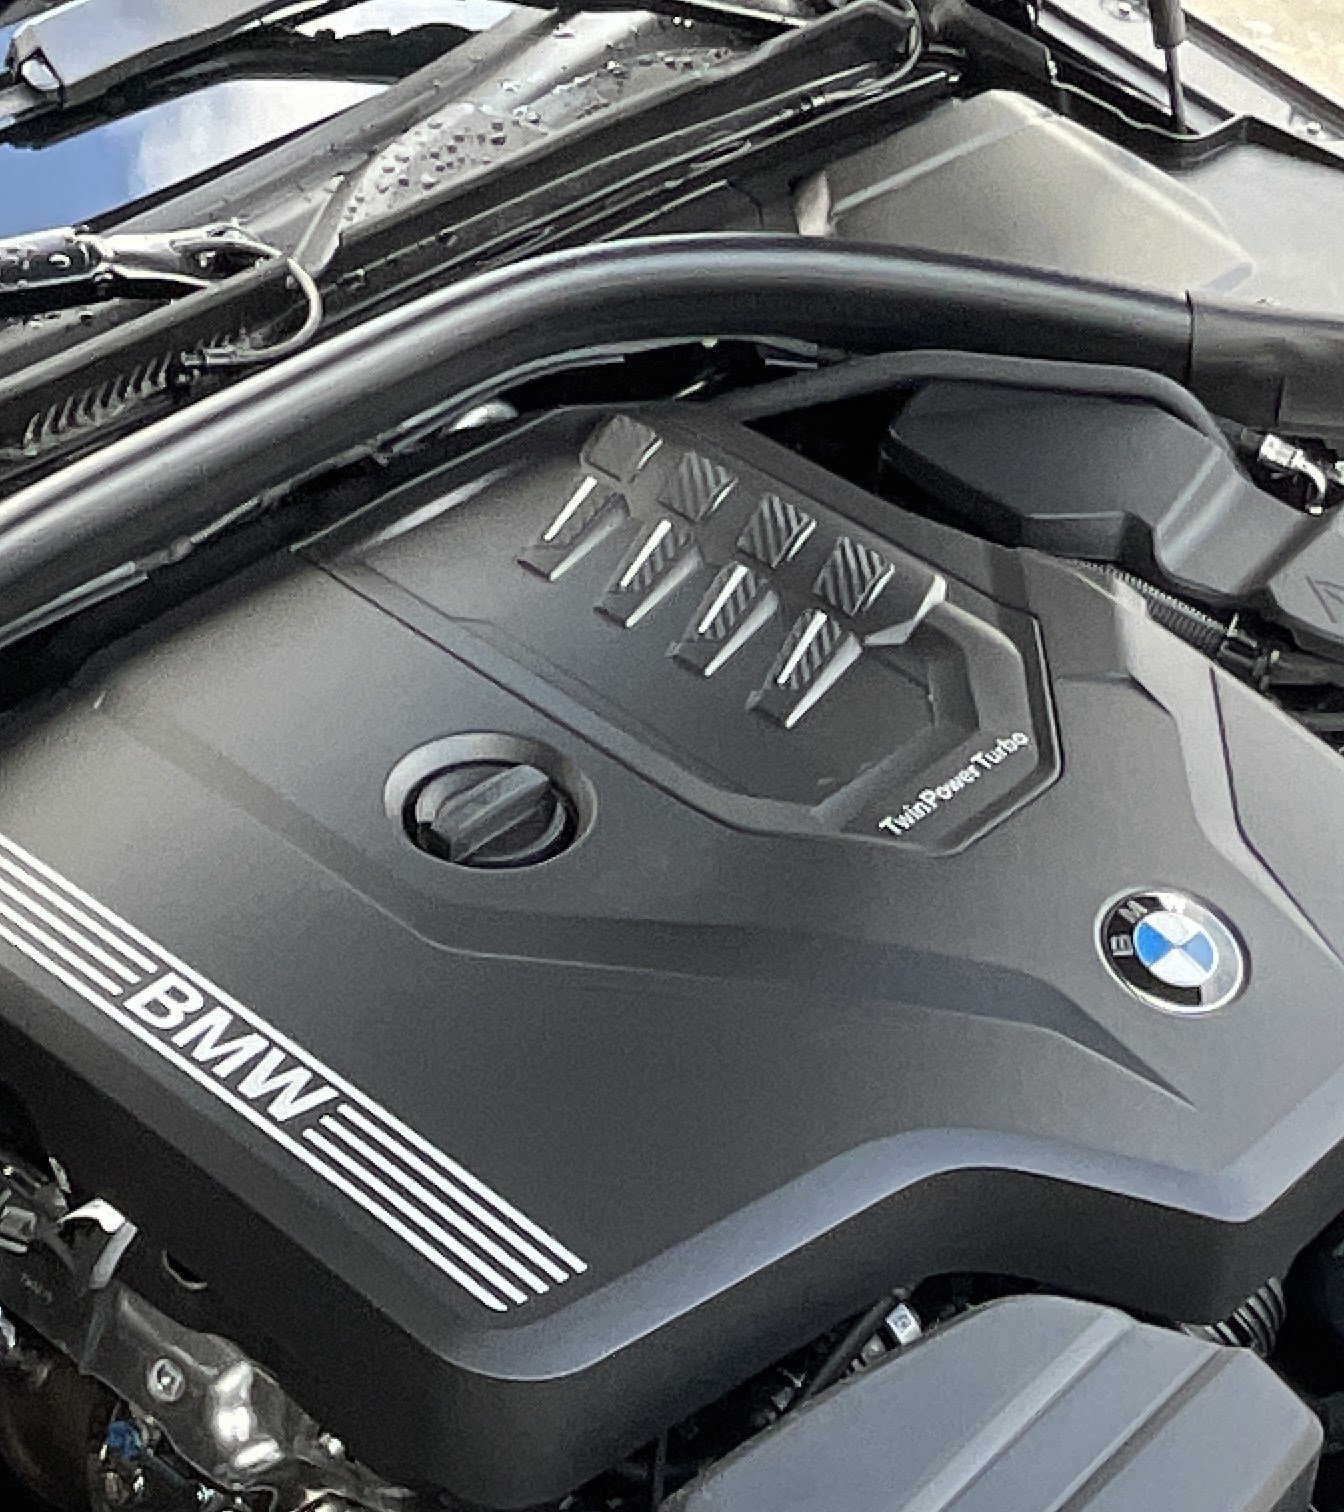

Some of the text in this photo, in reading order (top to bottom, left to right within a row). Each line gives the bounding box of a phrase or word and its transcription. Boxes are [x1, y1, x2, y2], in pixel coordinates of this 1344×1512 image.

[879, 732, 1029, 836] TwinPower Turbo
[123, 973, 339, 1121] BMW
